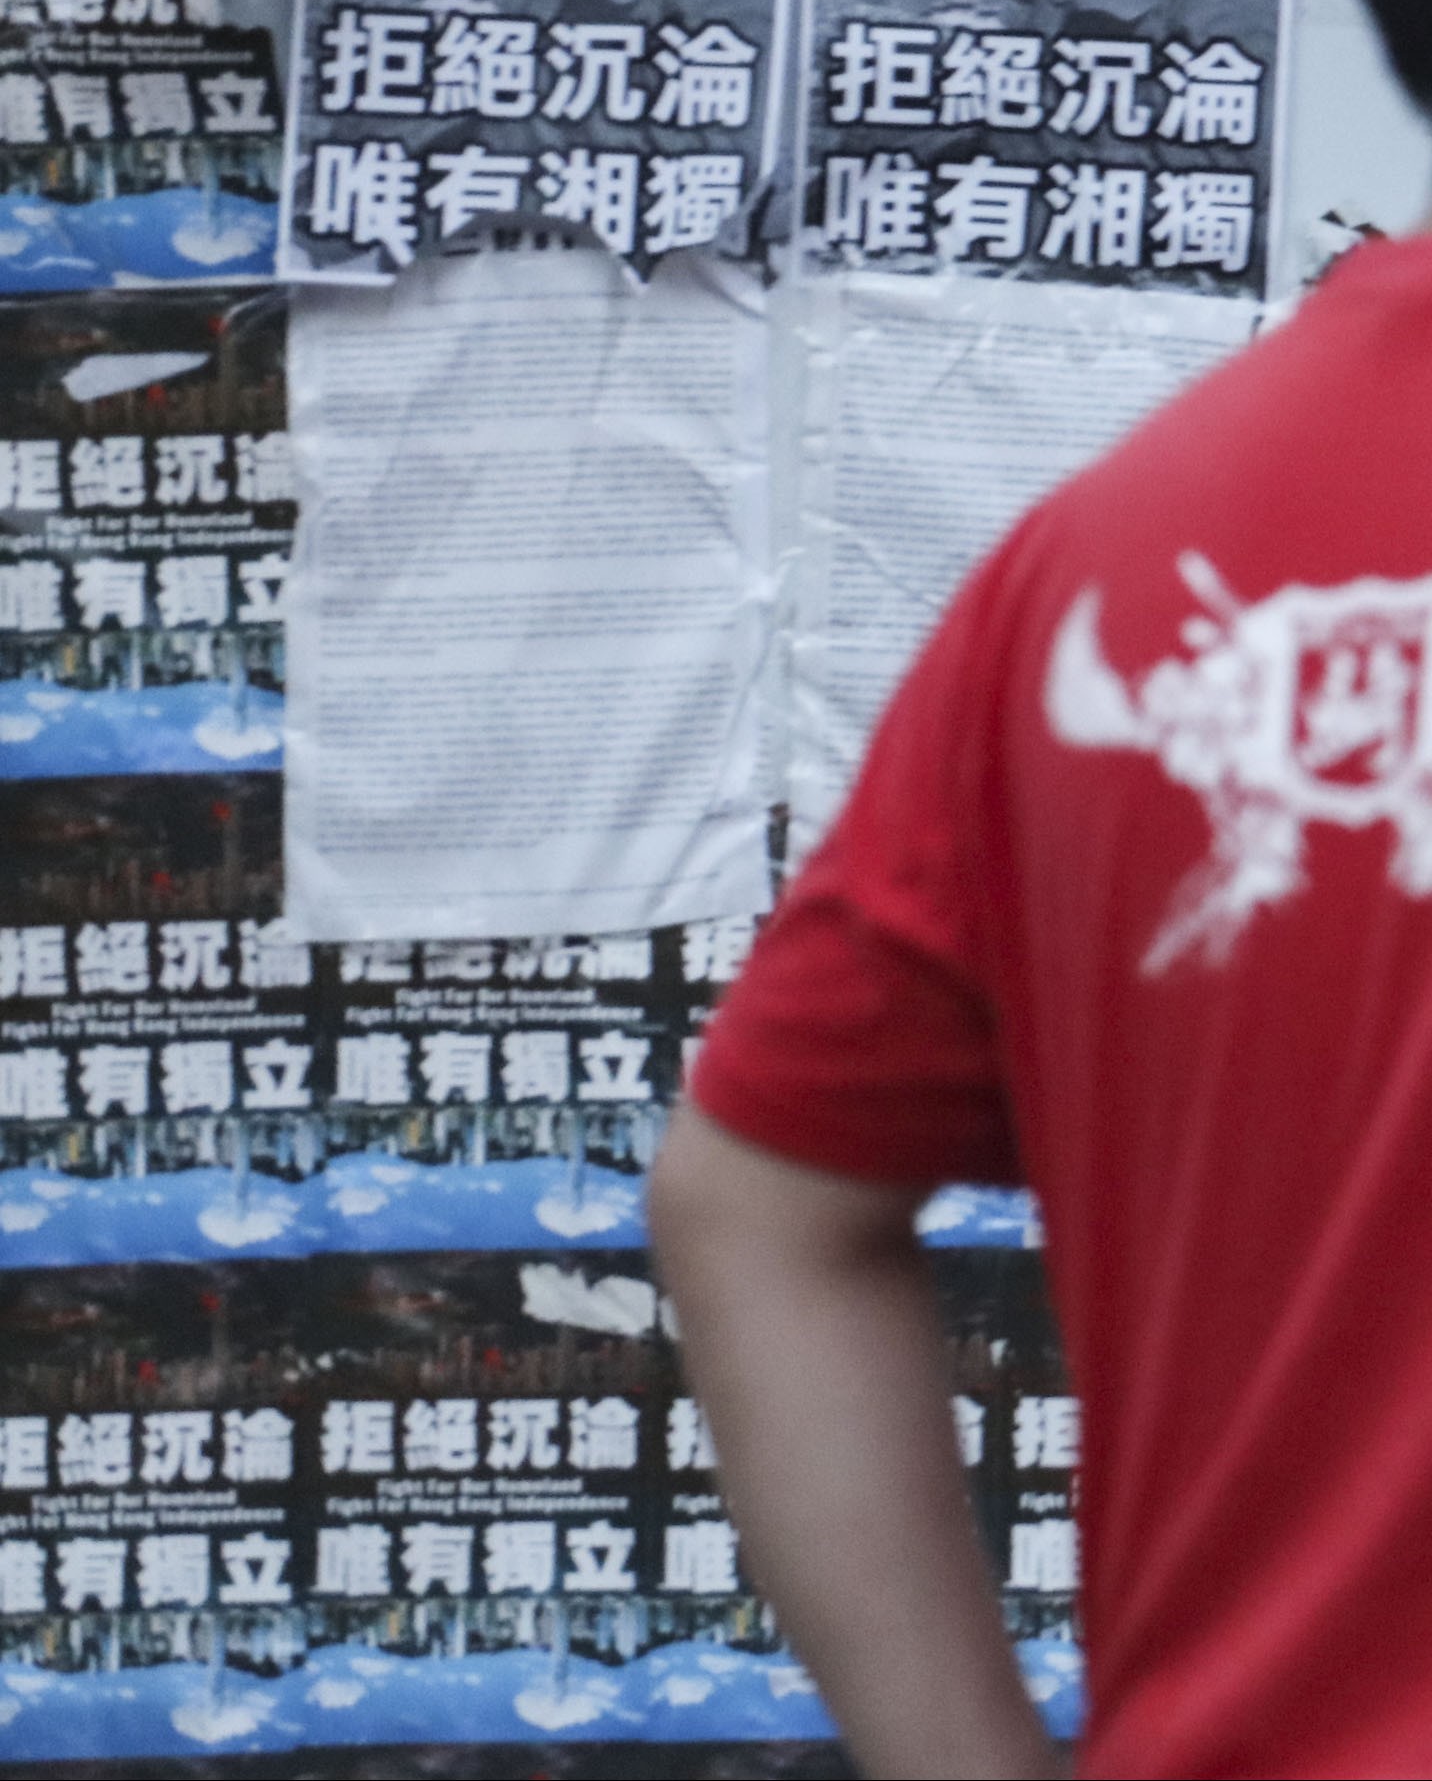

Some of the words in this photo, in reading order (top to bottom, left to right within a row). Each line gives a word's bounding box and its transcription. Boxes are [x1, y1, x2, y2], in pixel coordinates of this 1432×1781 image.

[320, 10, 758, 128] 拒絕沉淪
[827, 21, 1263, 145] 拒絕沉淪
[310, 141, 748, 269] 唯有湘獨
[822, 153, 1256, 273] 唯有湘獨
[0, 919, 313, 998] 拒絕沉淪
[0, 1038, 313, 1118] 唯有獨立
[336, 1029, 652, 1104] 唯有獨立
[320, 1396, 640, 1474] 拒絕沉淪
[313, 1519, 638, 1596] 唯有獨立
